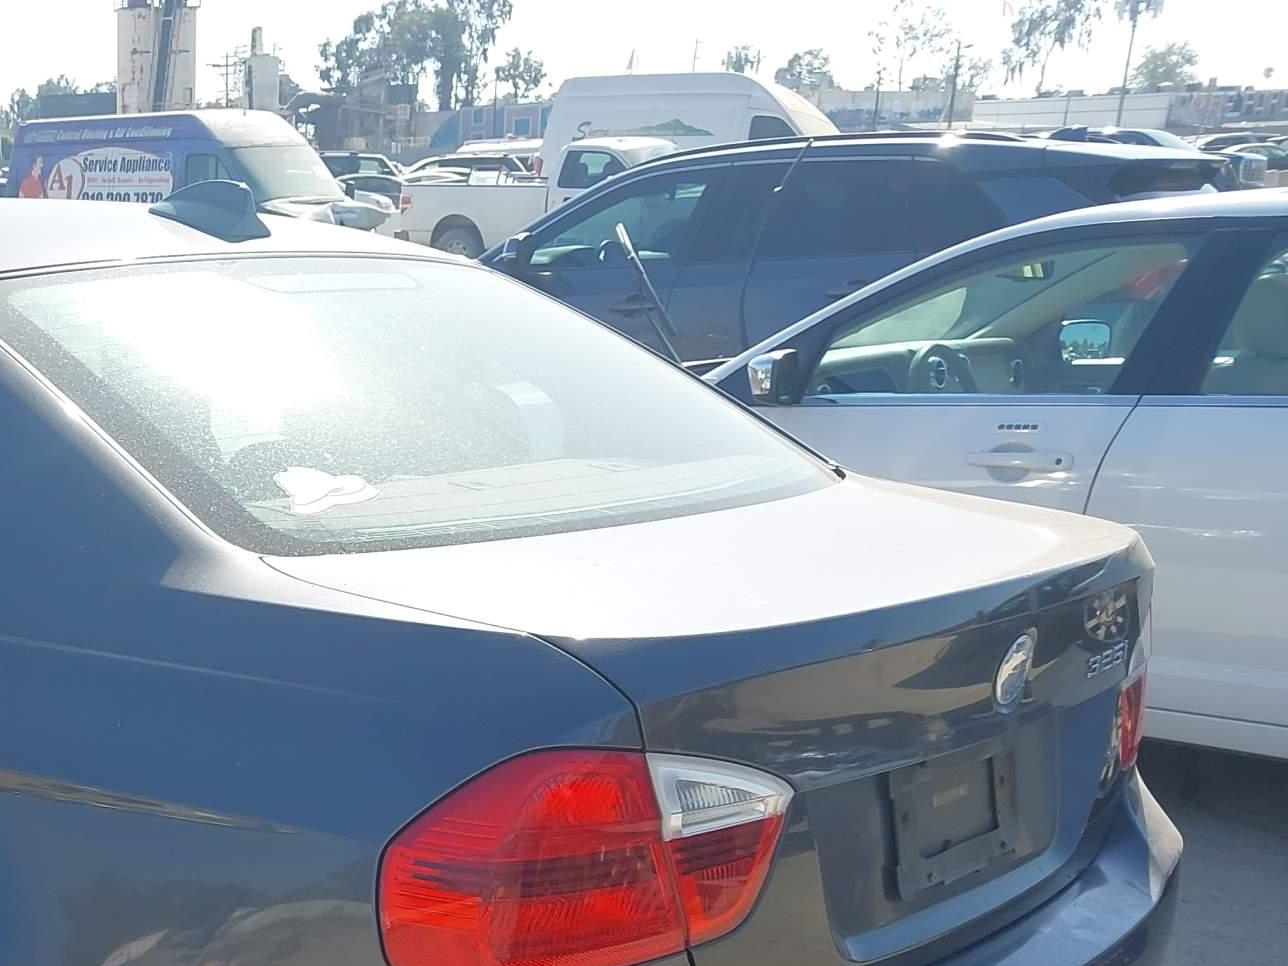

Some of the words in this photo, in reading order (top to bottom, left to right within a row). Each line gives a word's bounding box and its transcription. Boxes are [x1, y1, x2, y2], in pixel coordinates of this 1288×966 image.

[82, 156, 118, 173] Service
[120, 155, 171, 174] Appliance
[49, 163, 73, 200] A1
